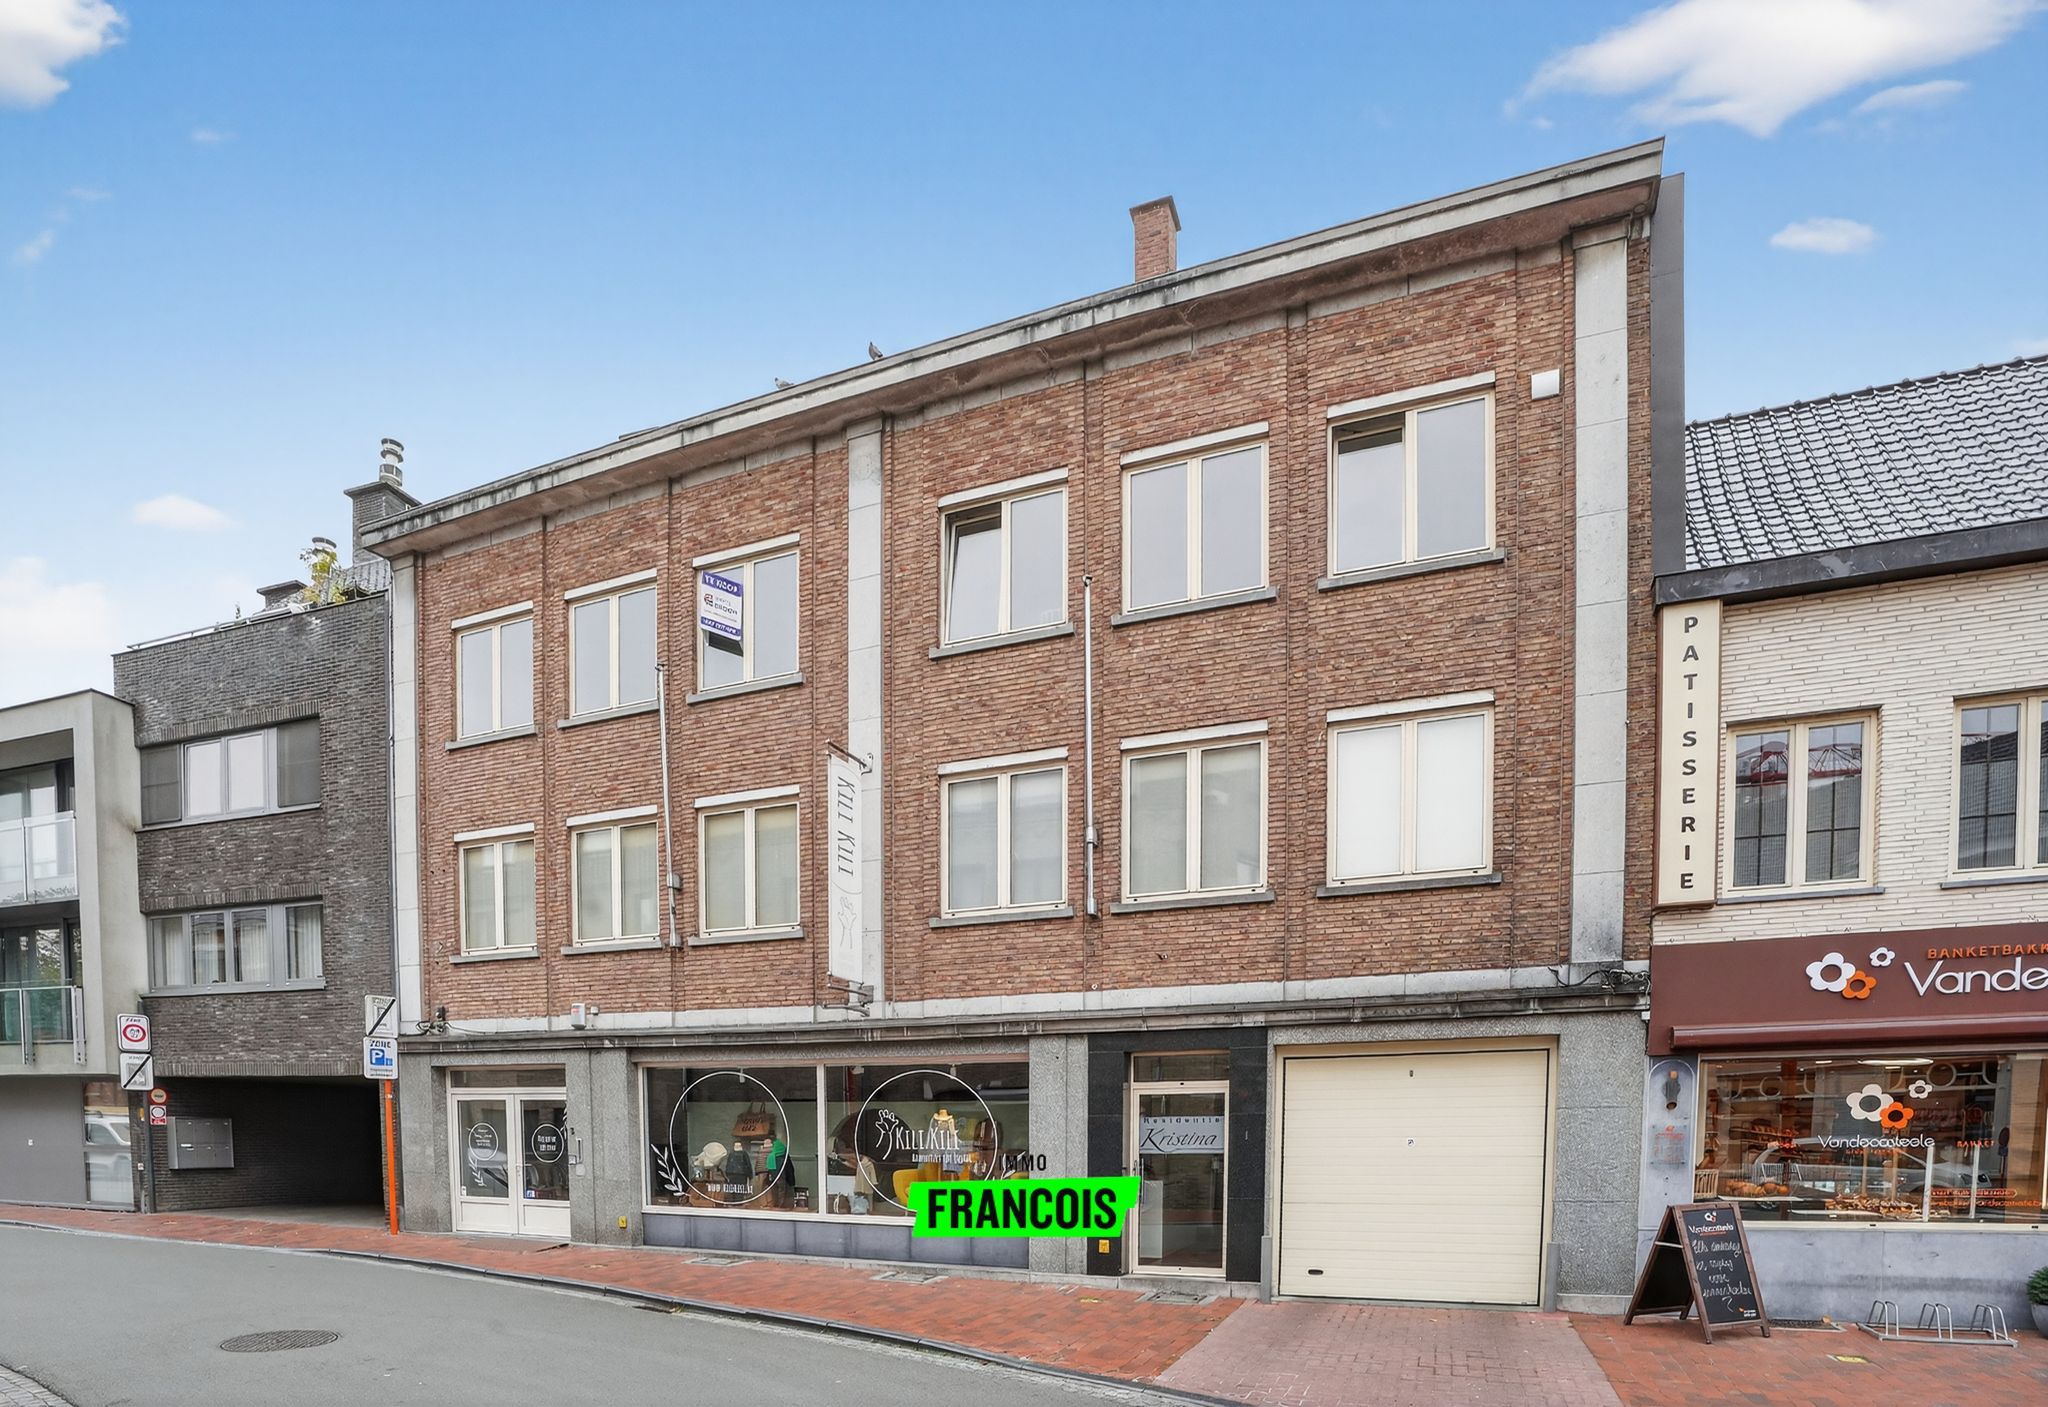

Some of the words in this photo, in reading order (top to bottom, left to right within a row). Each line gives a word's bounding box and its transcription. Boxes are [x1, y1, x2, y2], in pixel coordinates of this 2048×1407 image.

[1680, 616, 1699, 889] PATISSERIE
[1904, 956, 2048, 997] Vande
[1140, 1128, 1217, 1152] Kristina
